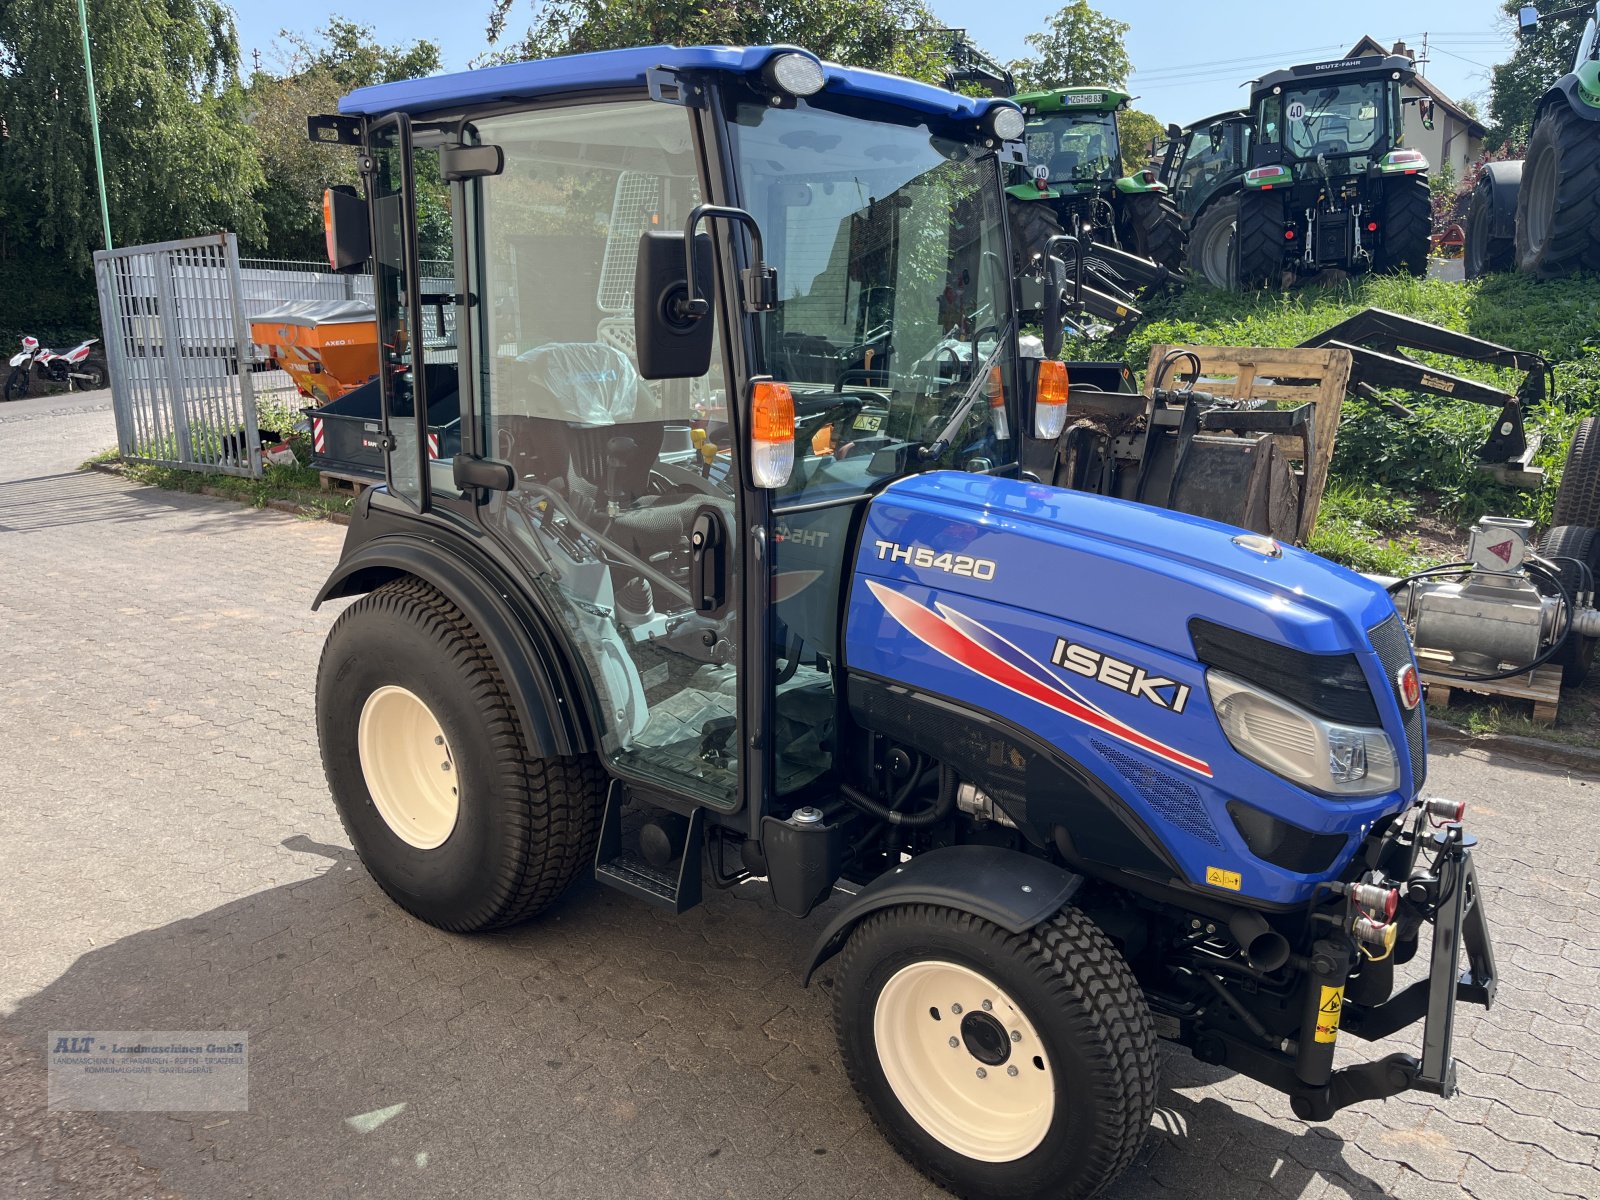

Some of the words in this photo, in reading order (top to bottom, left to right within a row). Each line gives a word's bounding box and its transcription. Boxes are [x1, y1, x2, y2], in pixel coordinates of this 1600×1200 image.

[1315, 60, 1361, 70] DEUTZ-FAHR
[1094, 94, 1102, 103] 83
[1290, 105, 1302, 118] 40
[1036, 168, 1047, 178] 40
[876, 540, 996, 581] TH5420
[1050, 636, 1192, 715] ISEKI
